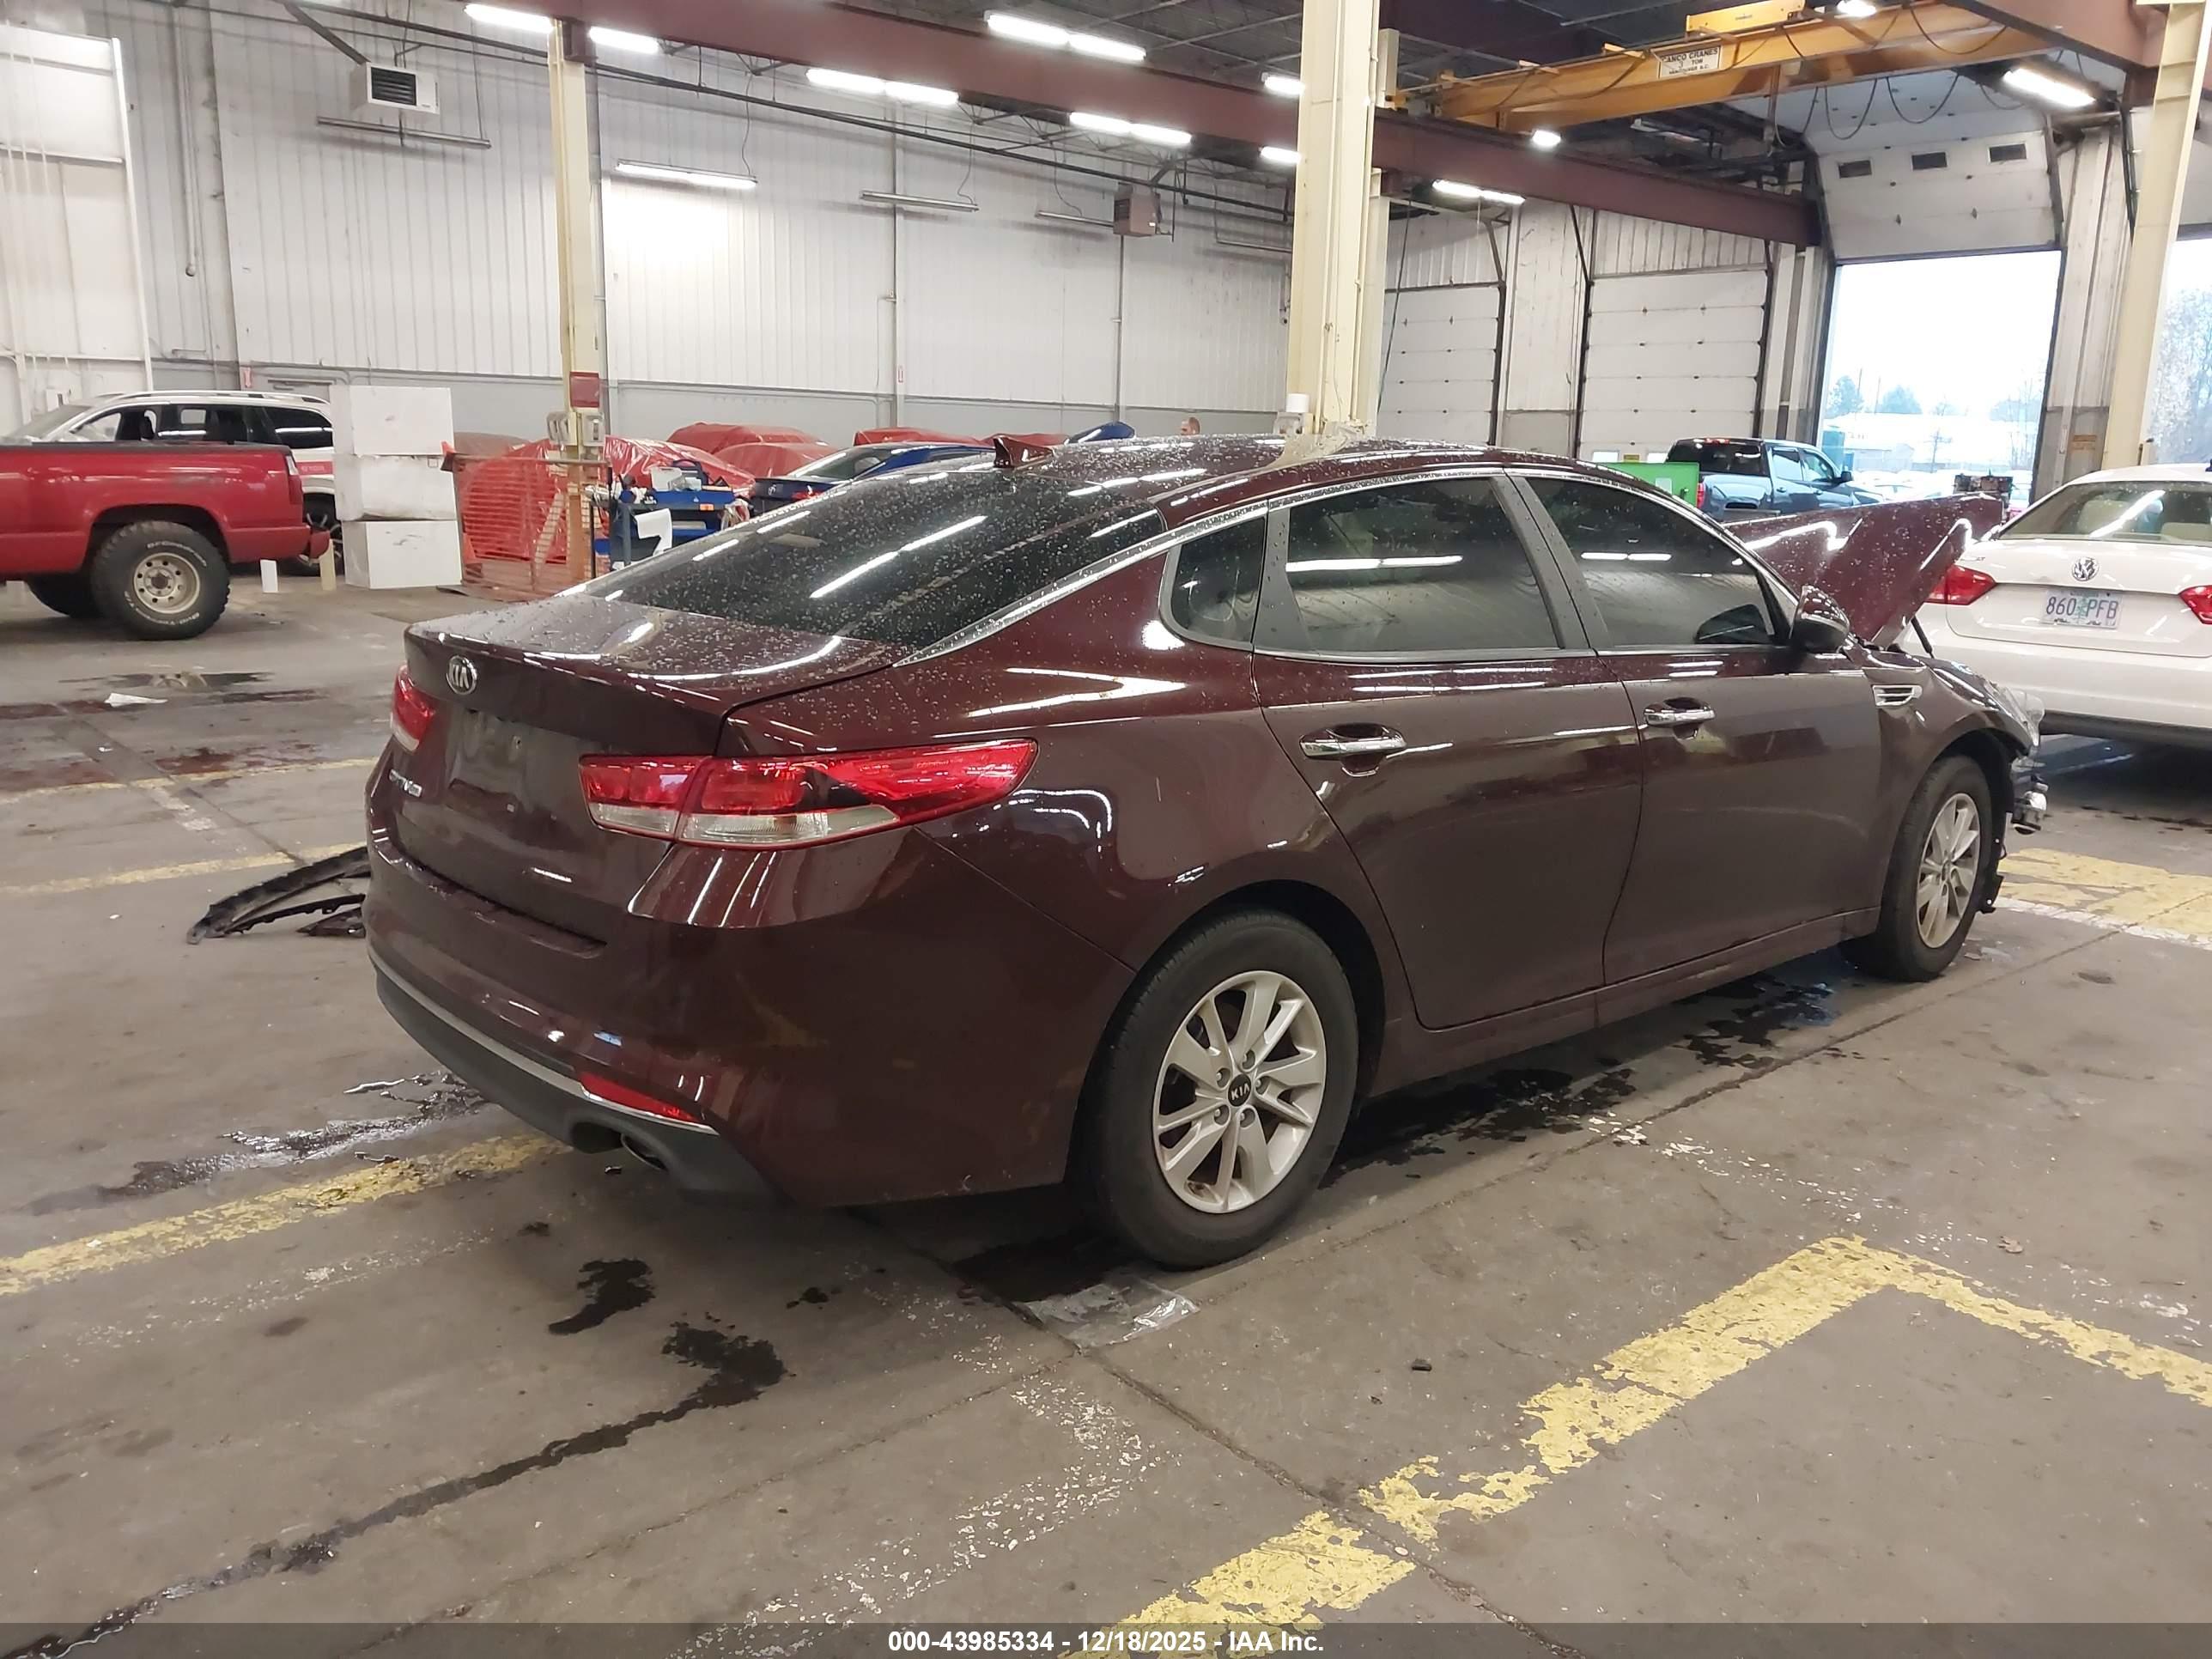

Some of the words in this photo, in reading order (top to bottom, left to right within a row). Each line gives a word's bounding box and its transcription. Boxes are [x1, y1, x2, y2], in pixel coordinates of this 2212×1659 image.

[2046, 597, 2077, 617] 860
[2085, 599, 2118, 619] PFB
[1231, 1083, 1250, 1101] KIA
